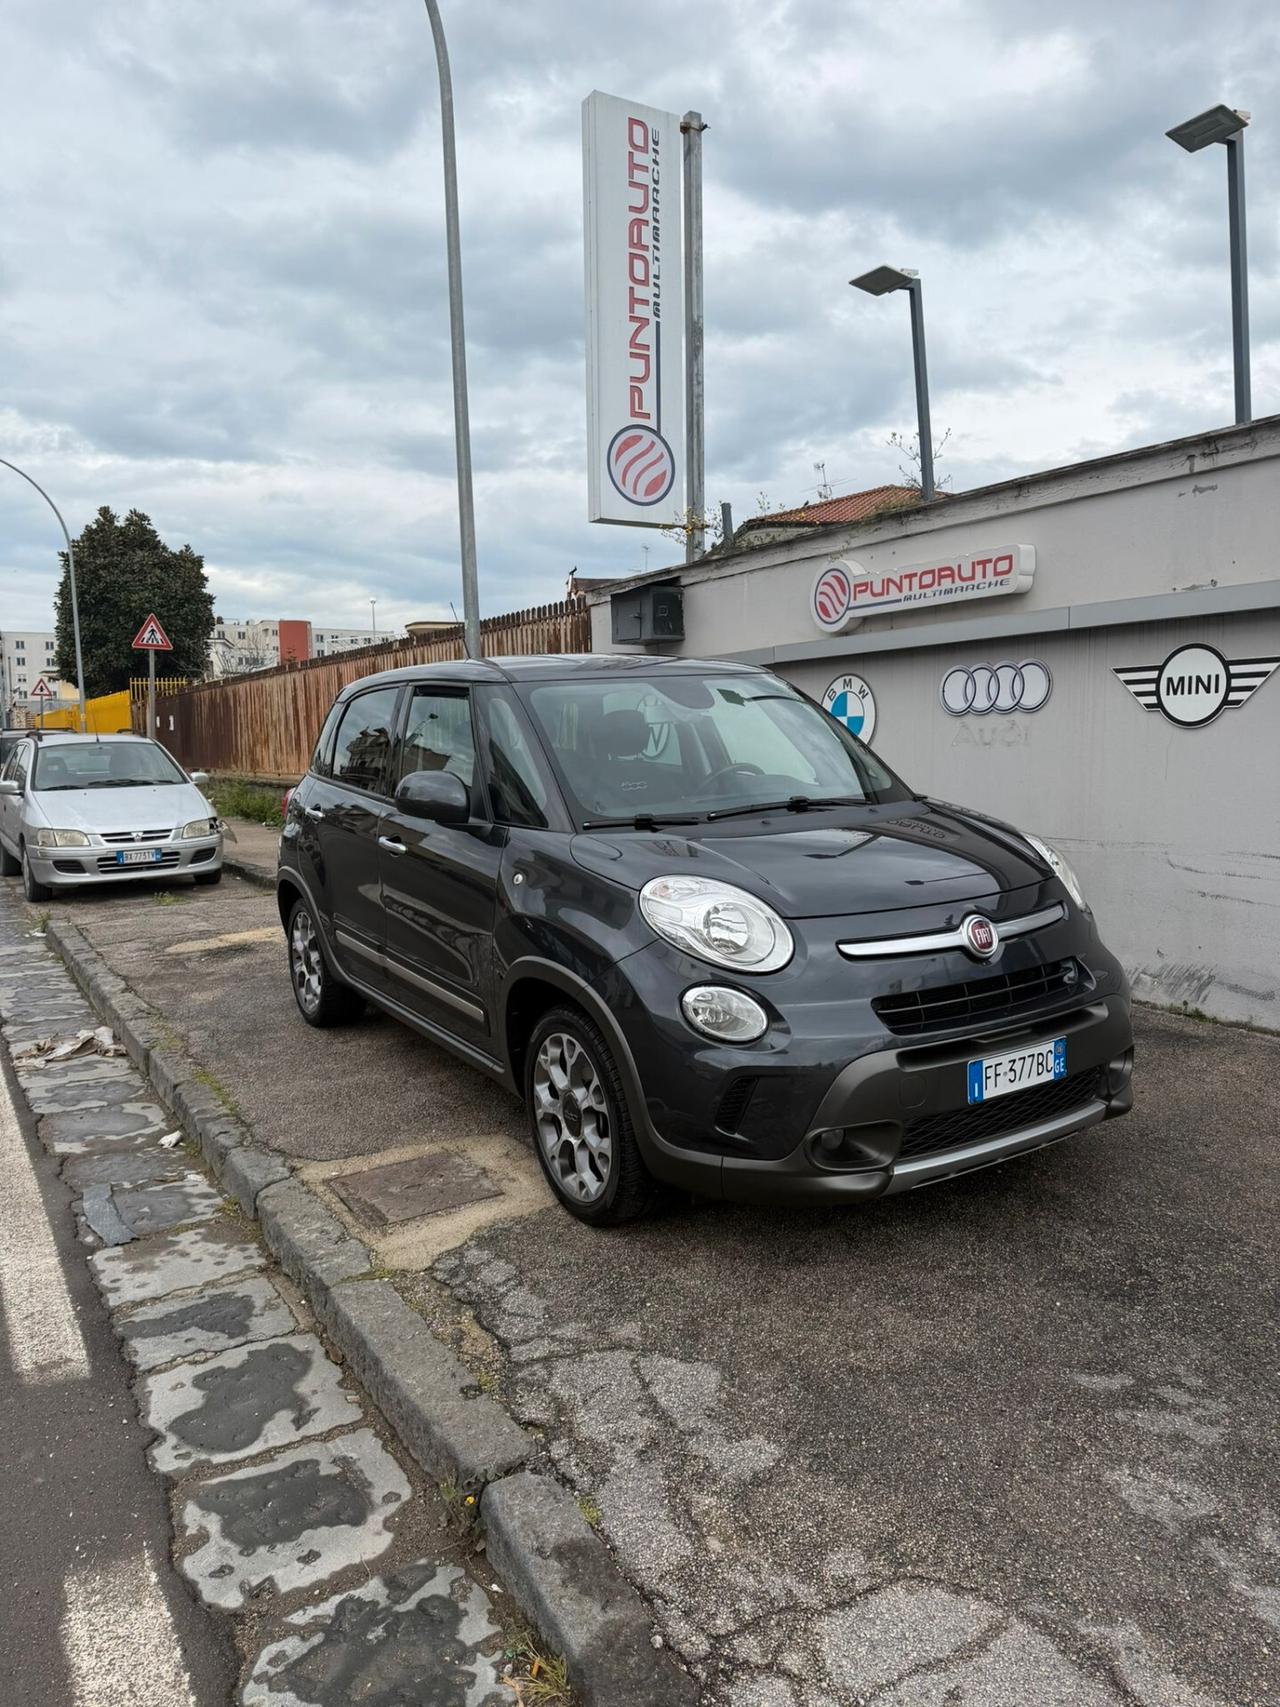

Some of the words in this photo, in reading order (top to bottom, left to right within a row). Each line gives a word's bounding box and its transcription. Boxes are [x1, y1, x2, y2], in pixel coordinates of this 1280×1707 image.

[652, 128, 661, 319] MULTIMARCHE
[628, 116, 650, 420] PUNTOAUTO
[853, 554, 1013, 601] PUNTOAUTO
[903, 578, 1010, 602] MULTIMARCHE
[827, 678, 869, 702] BMW
[1166, 673, 1220, 696] MINI
[975, 927, 993, 945] FIAT
[1055, 1058, 1064, 1073] GE
